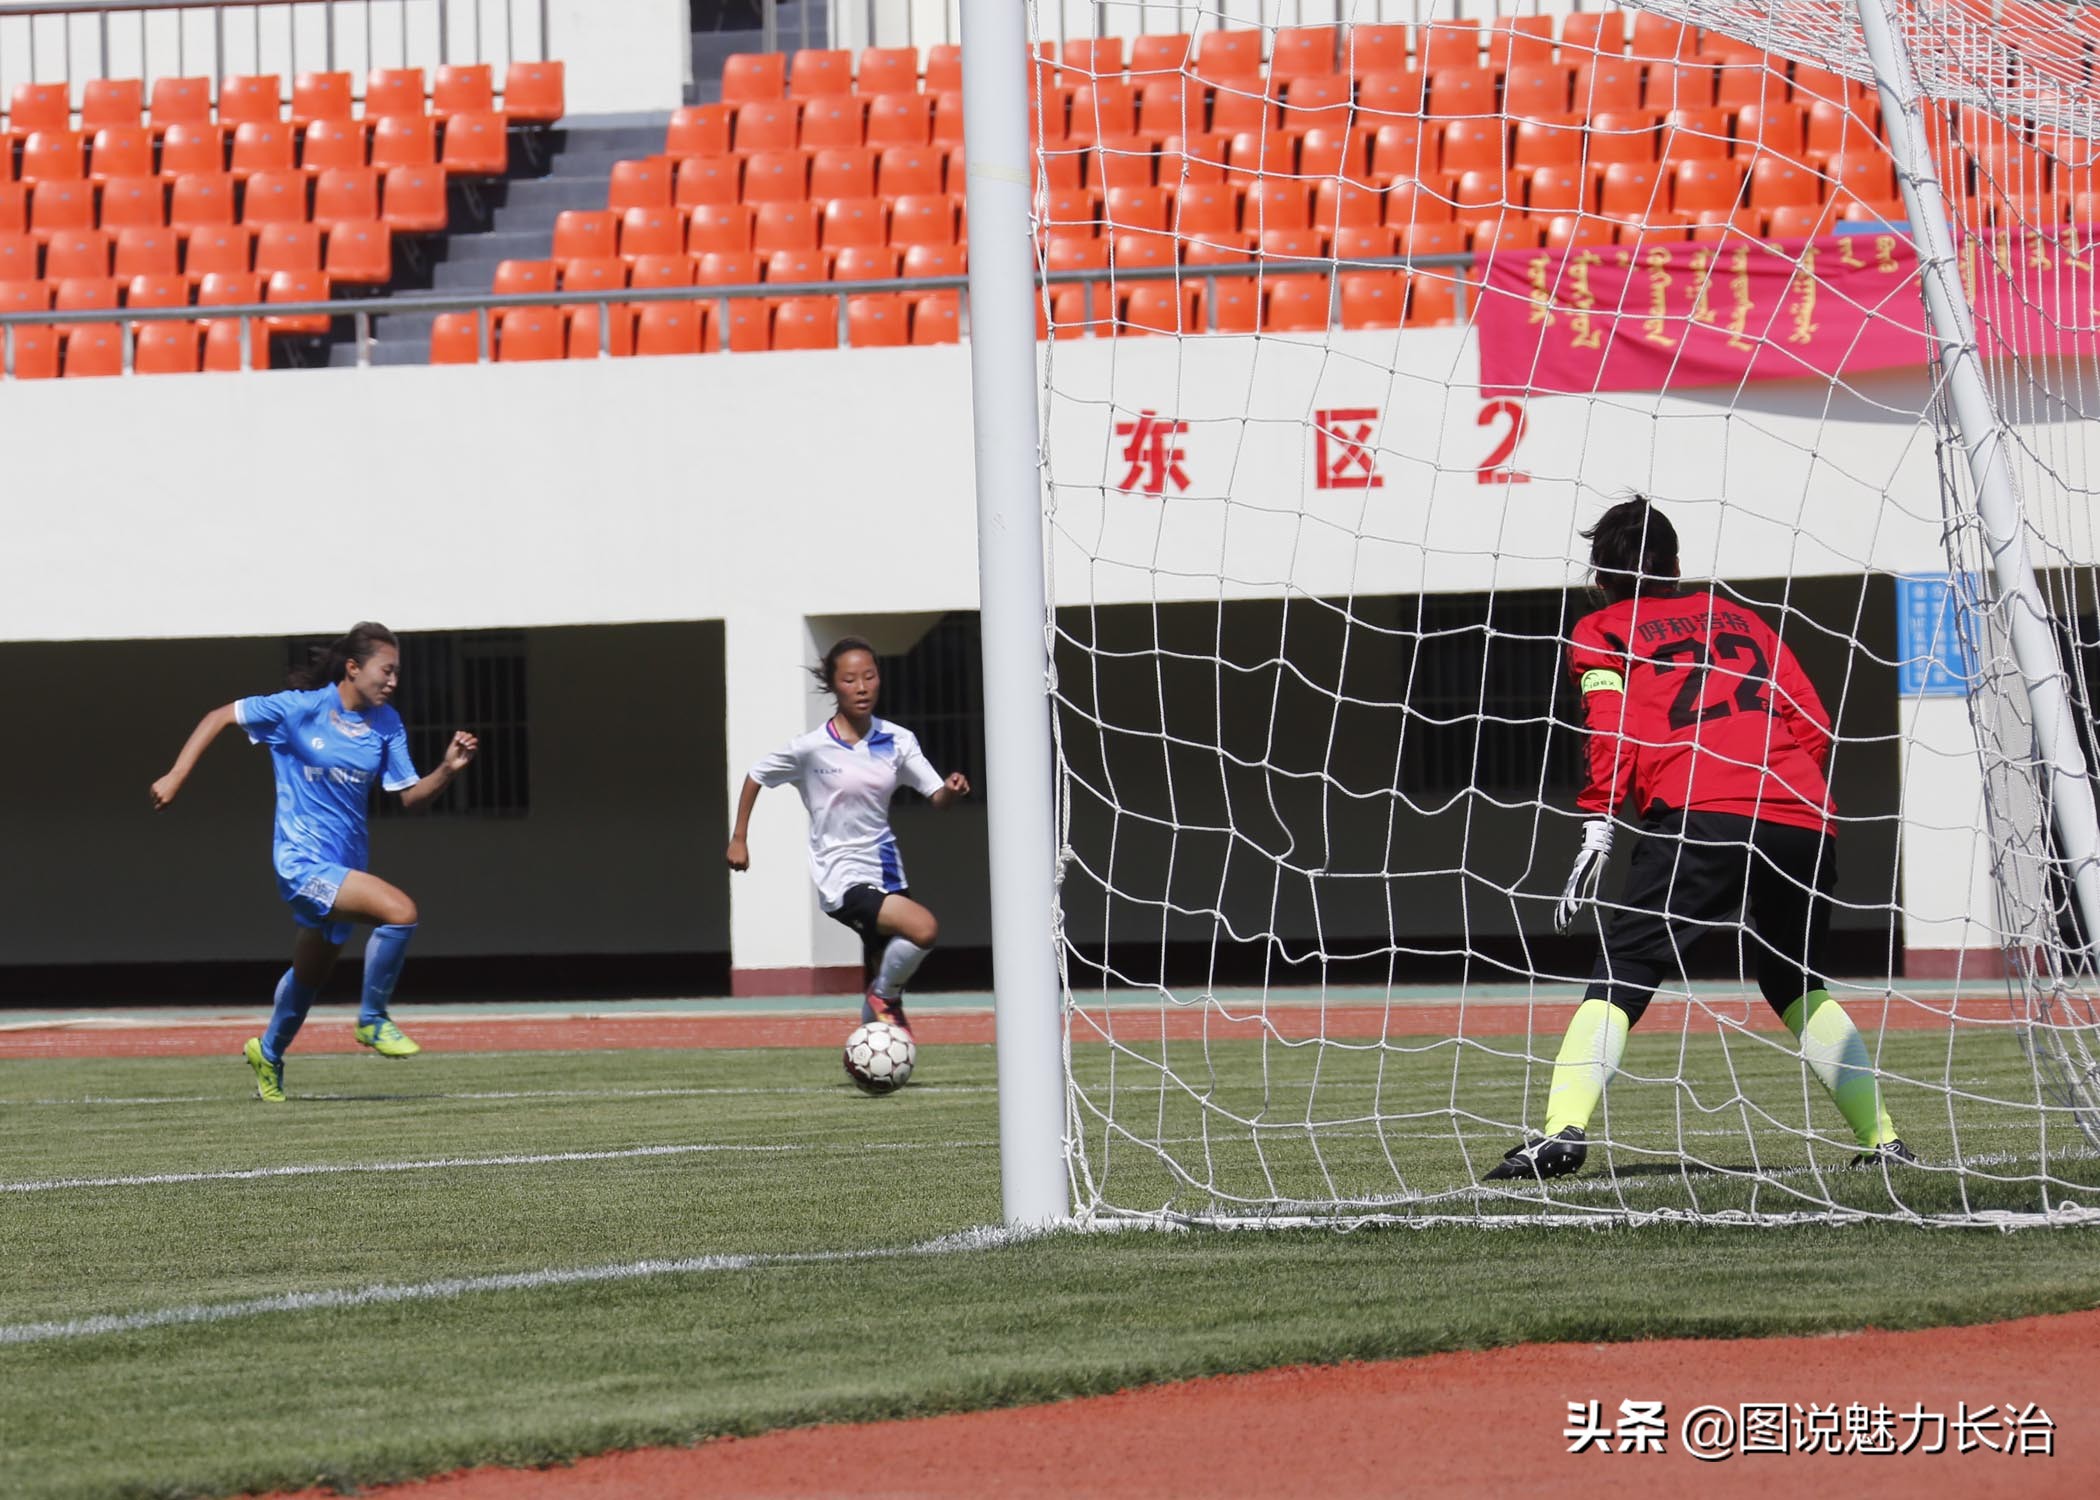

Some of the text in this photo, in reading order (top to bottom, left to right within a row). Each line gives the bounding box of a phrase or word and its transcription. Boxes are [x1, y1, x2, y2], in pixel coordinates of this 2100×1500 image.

[1115, 399, 1531, 496] 东 区 2
[1652, 632, 1782, 732] 22
